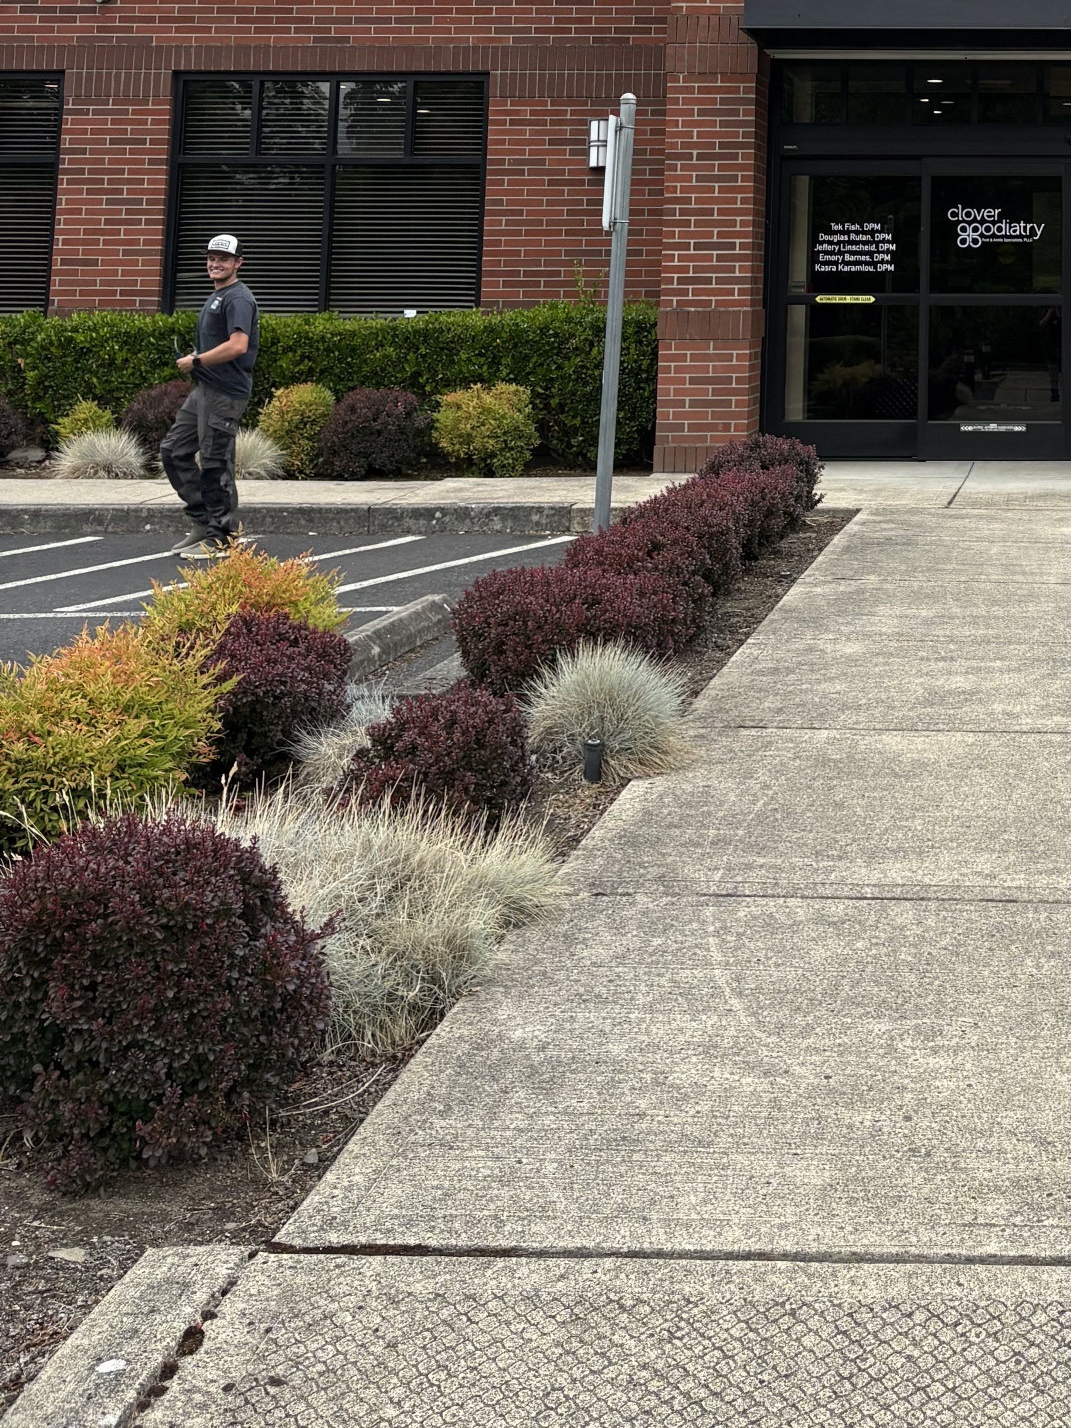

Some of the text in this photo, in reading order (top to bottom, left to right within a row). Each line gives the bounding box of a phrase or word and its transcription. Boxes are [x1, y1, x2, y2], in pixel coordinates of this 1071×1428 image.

[947, 204, 1001, 221] clover
[830, 223, 843, 231] Tek
[863, 223, 881, 231] DPM
[969, 219, 1045, 242] podiatry
[818, 233, 849, 243] Douglas
[874, 233, 892, 241] DPM
[814, 243, 840, 253] Jeffery
[878, 243, 896, 251] DPM
[819, 253, 843, 263] Emory
[873, 253, 891, 262] DPM
[815, 264, 837, 272] Kasra
[877, 264, 895, 272] DPM
